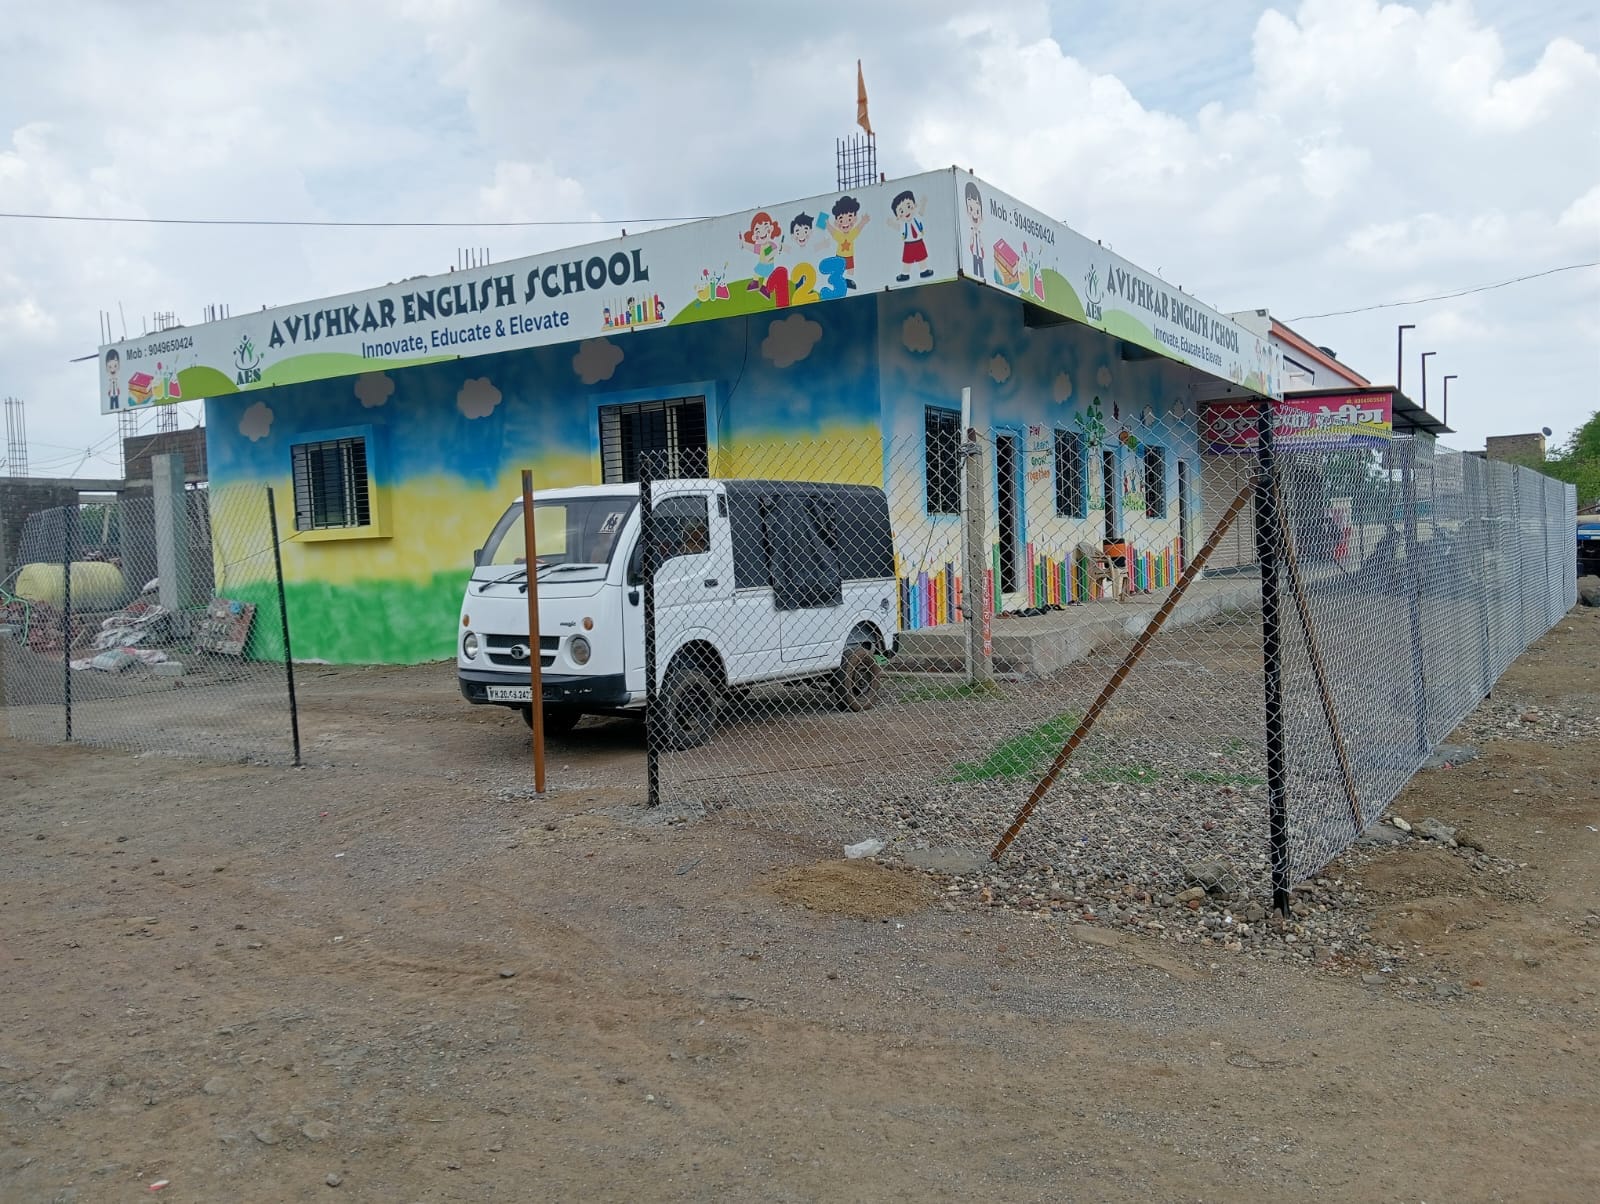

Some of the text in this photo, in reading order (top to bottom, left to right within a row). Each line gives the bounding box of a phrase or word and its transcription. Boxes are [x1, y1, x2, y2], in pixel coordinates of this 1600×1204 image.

[990, 198, 1007, 221] Mob
[1013, 210, 1055, 245] 9049650424
[268, 247, 650, 349] AVISHKAR ENGLISH SCHOOL
[1085, 301, 1103, 321] AES
[1107, 263, 1240, 354] AVISHKAR ENGLISH SCHOOL
[126, 346, 143, 360] Mob
[148, 336, 194, 356] 9049650424
[362, 309, 570, 359] Innovate, Educate & Elevate
[236, 367, 262, 386] AES
